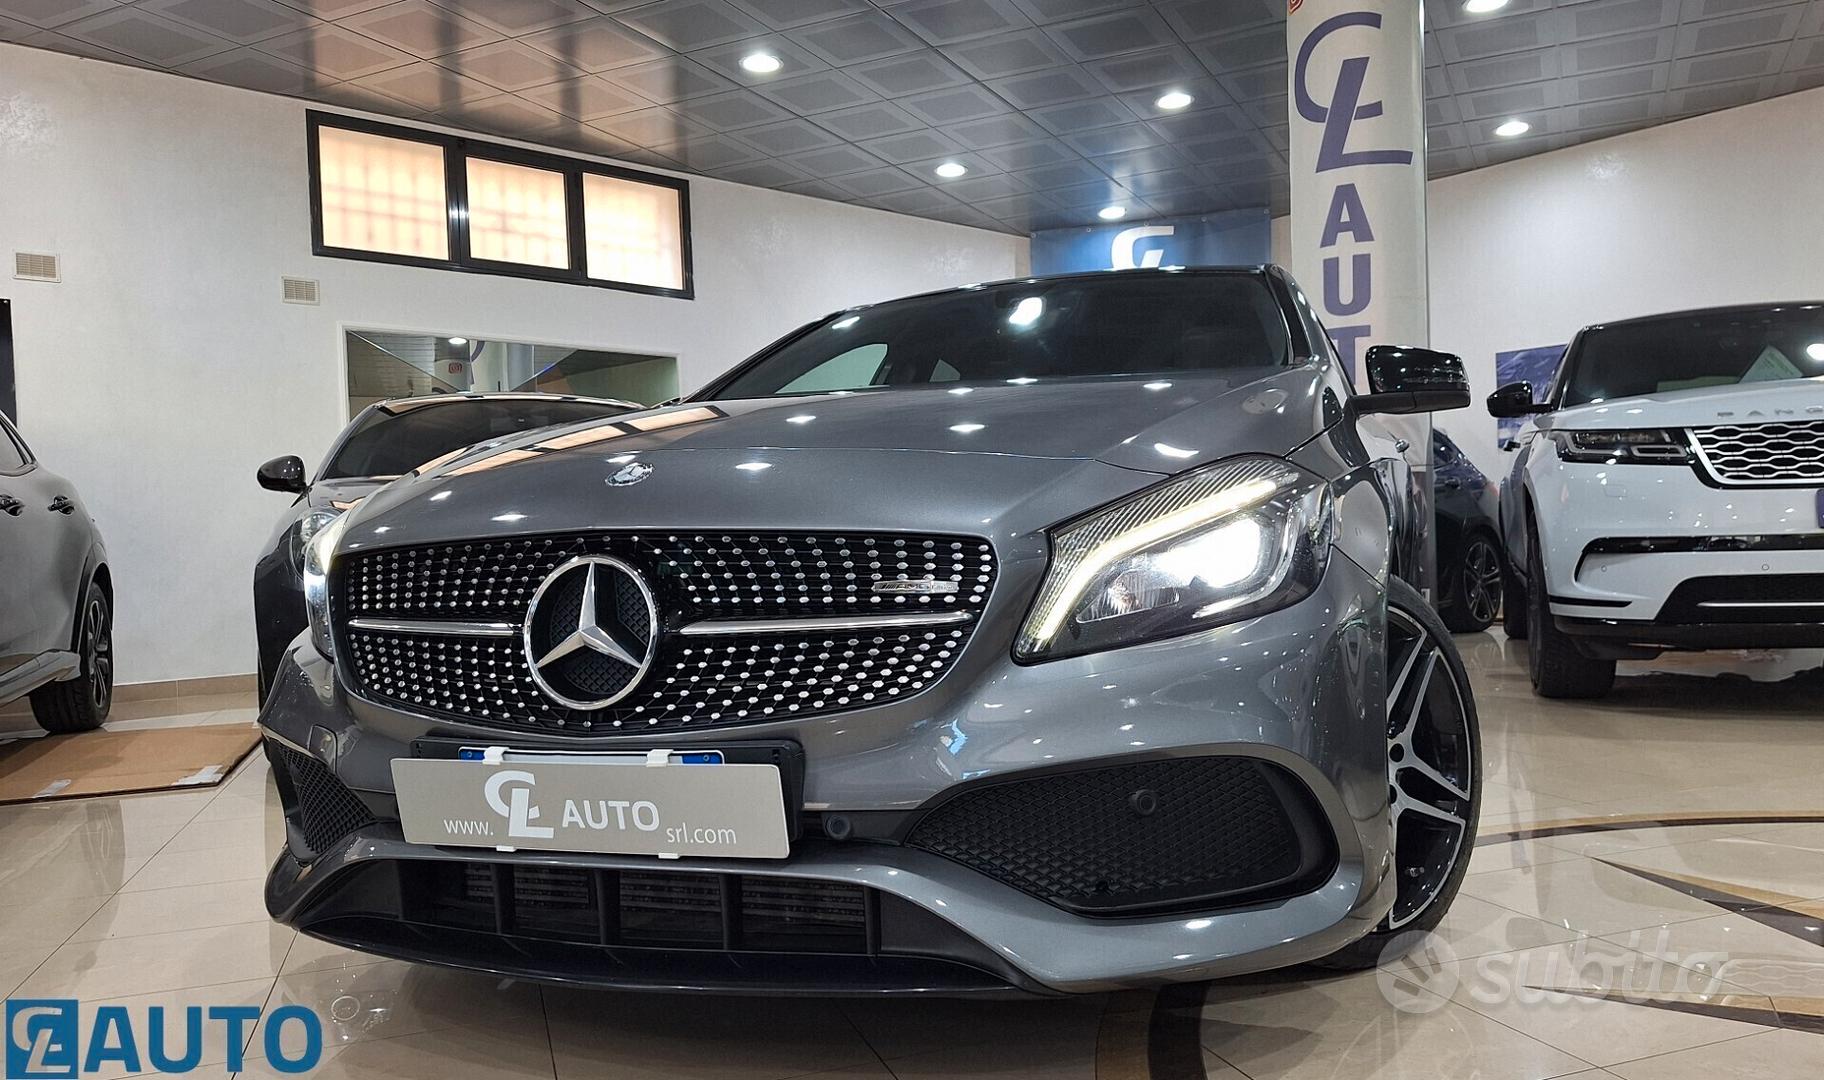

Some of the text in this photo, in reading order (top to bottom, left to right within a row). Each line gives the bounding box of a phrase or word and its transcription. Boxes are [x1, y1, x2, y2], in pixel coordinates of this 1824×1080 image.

[443, 770, 737, 845] www. CL AUTO srl.com
